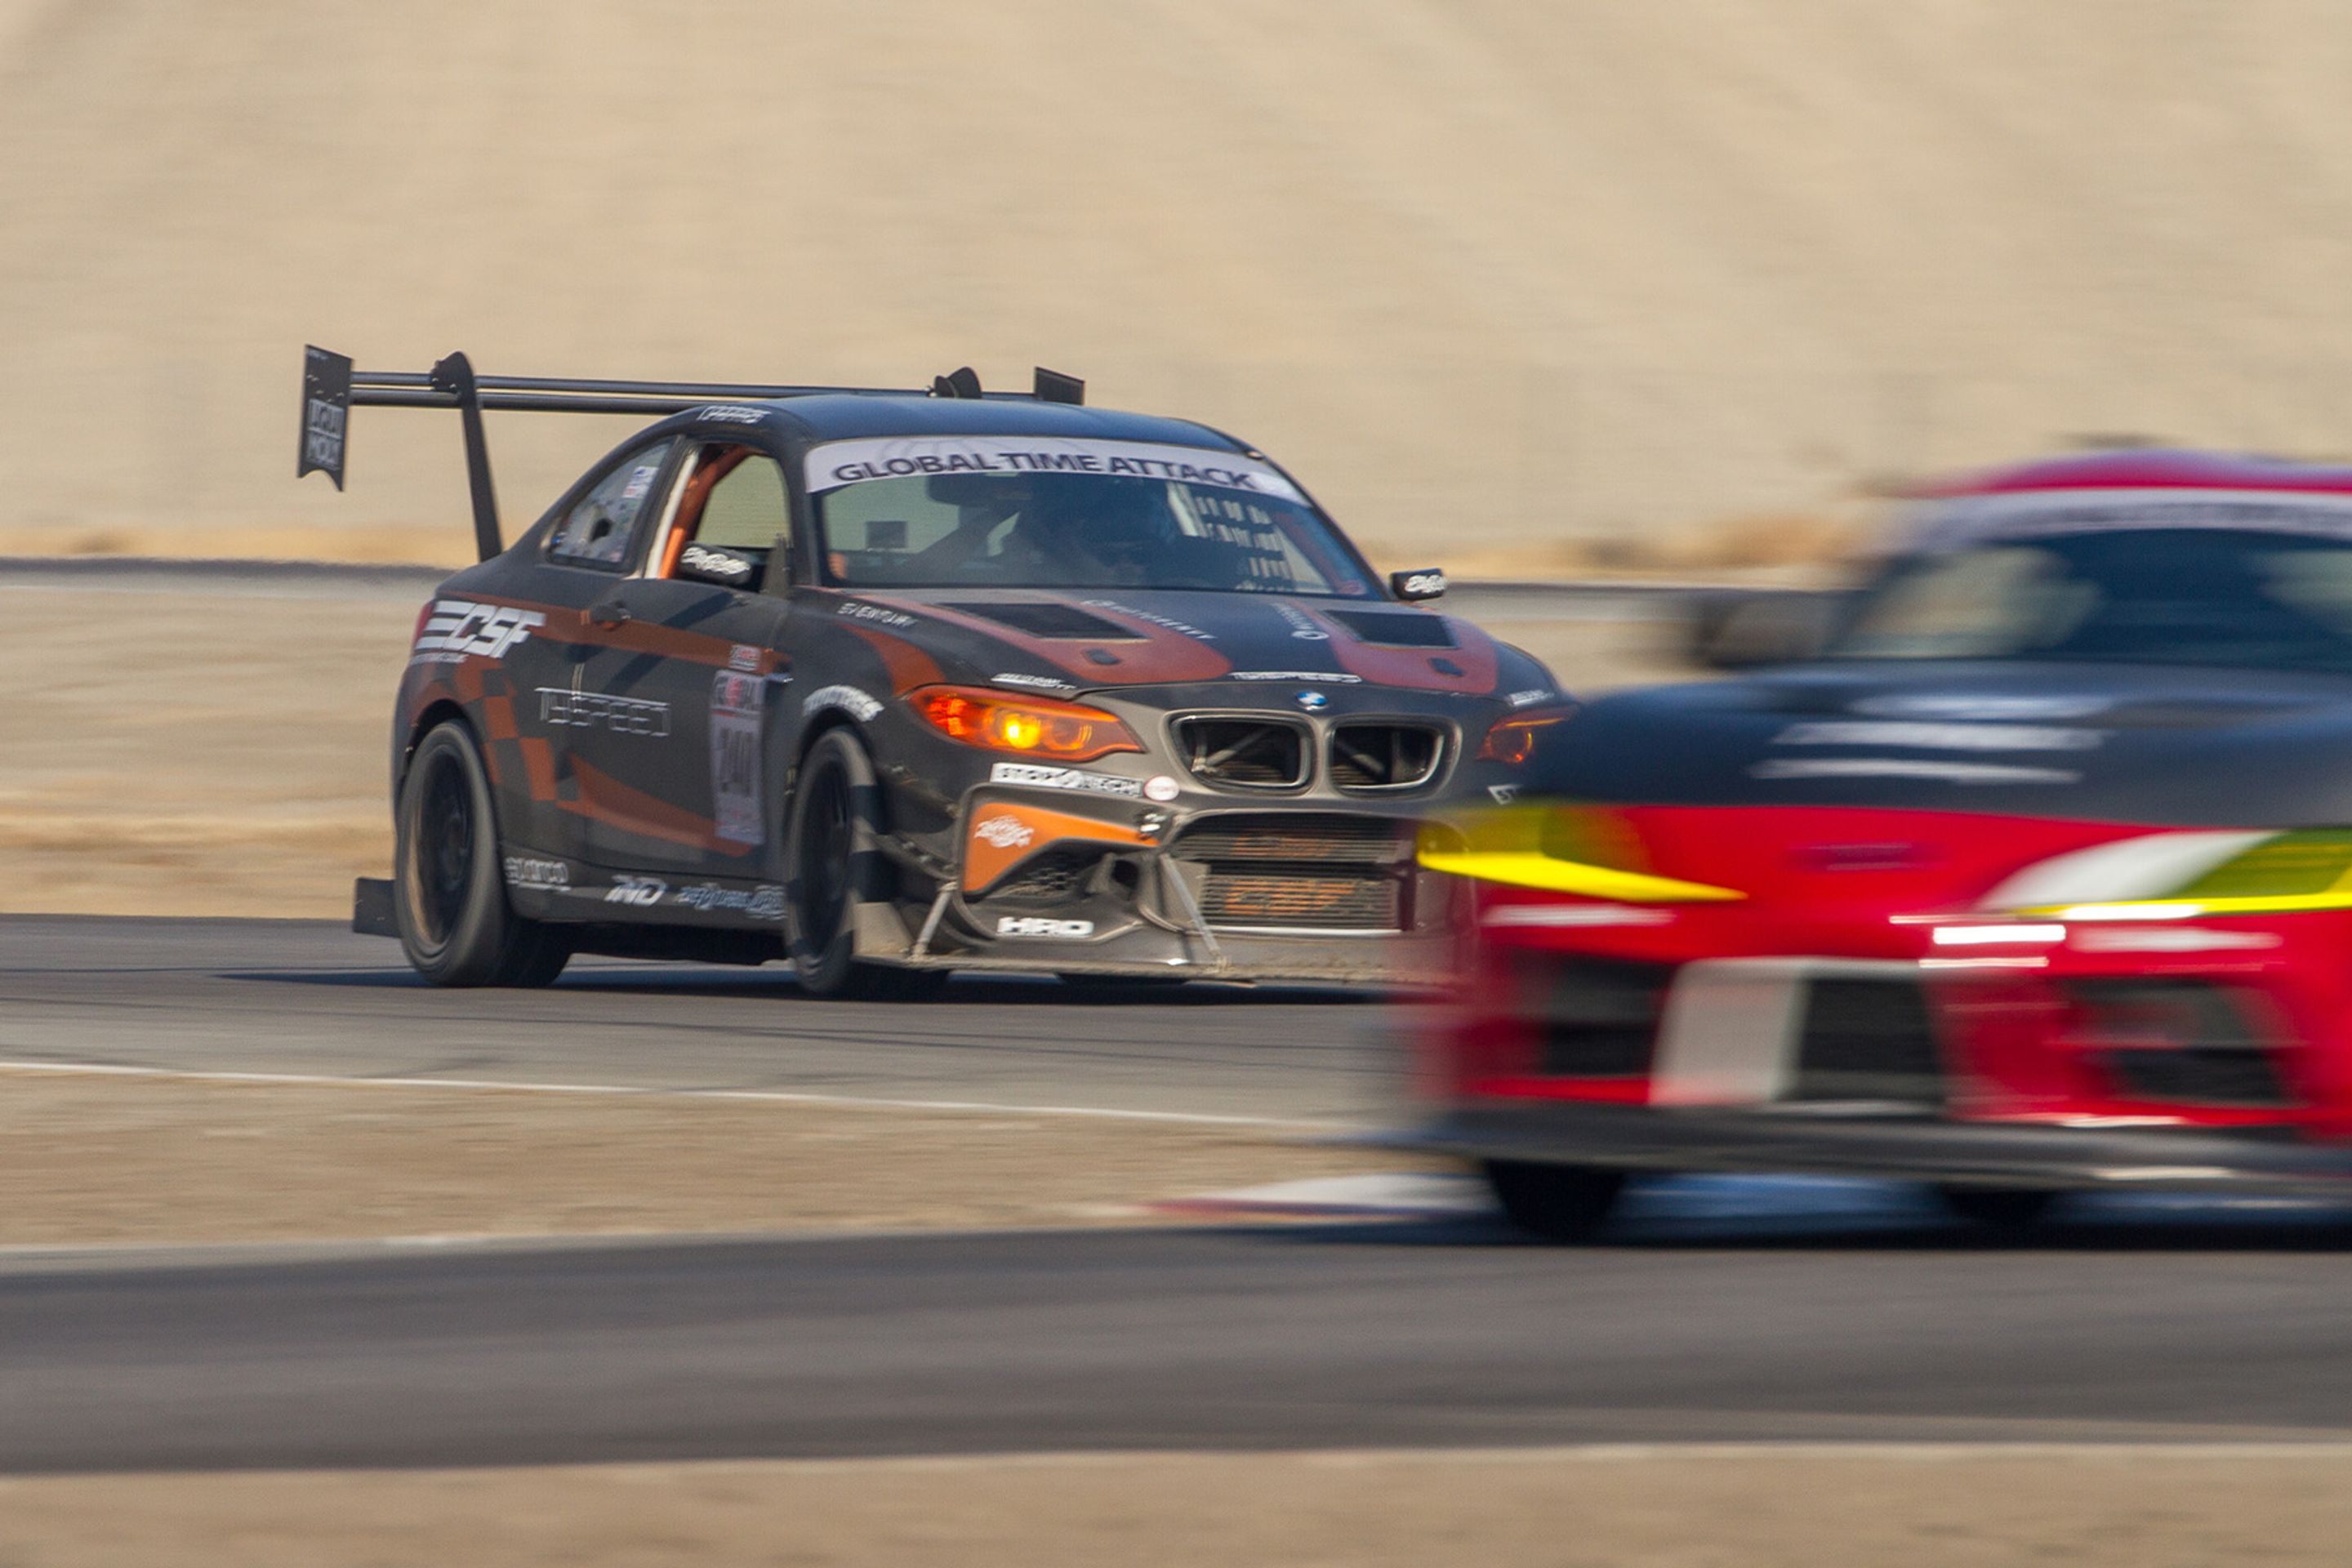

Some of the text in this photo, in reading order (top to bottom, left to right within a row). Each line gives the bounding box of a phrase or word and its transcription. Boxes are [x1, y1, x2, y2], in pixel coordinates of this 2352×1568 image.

[832, 452, 1258, 490] GLOBAL TIME ATTACK
